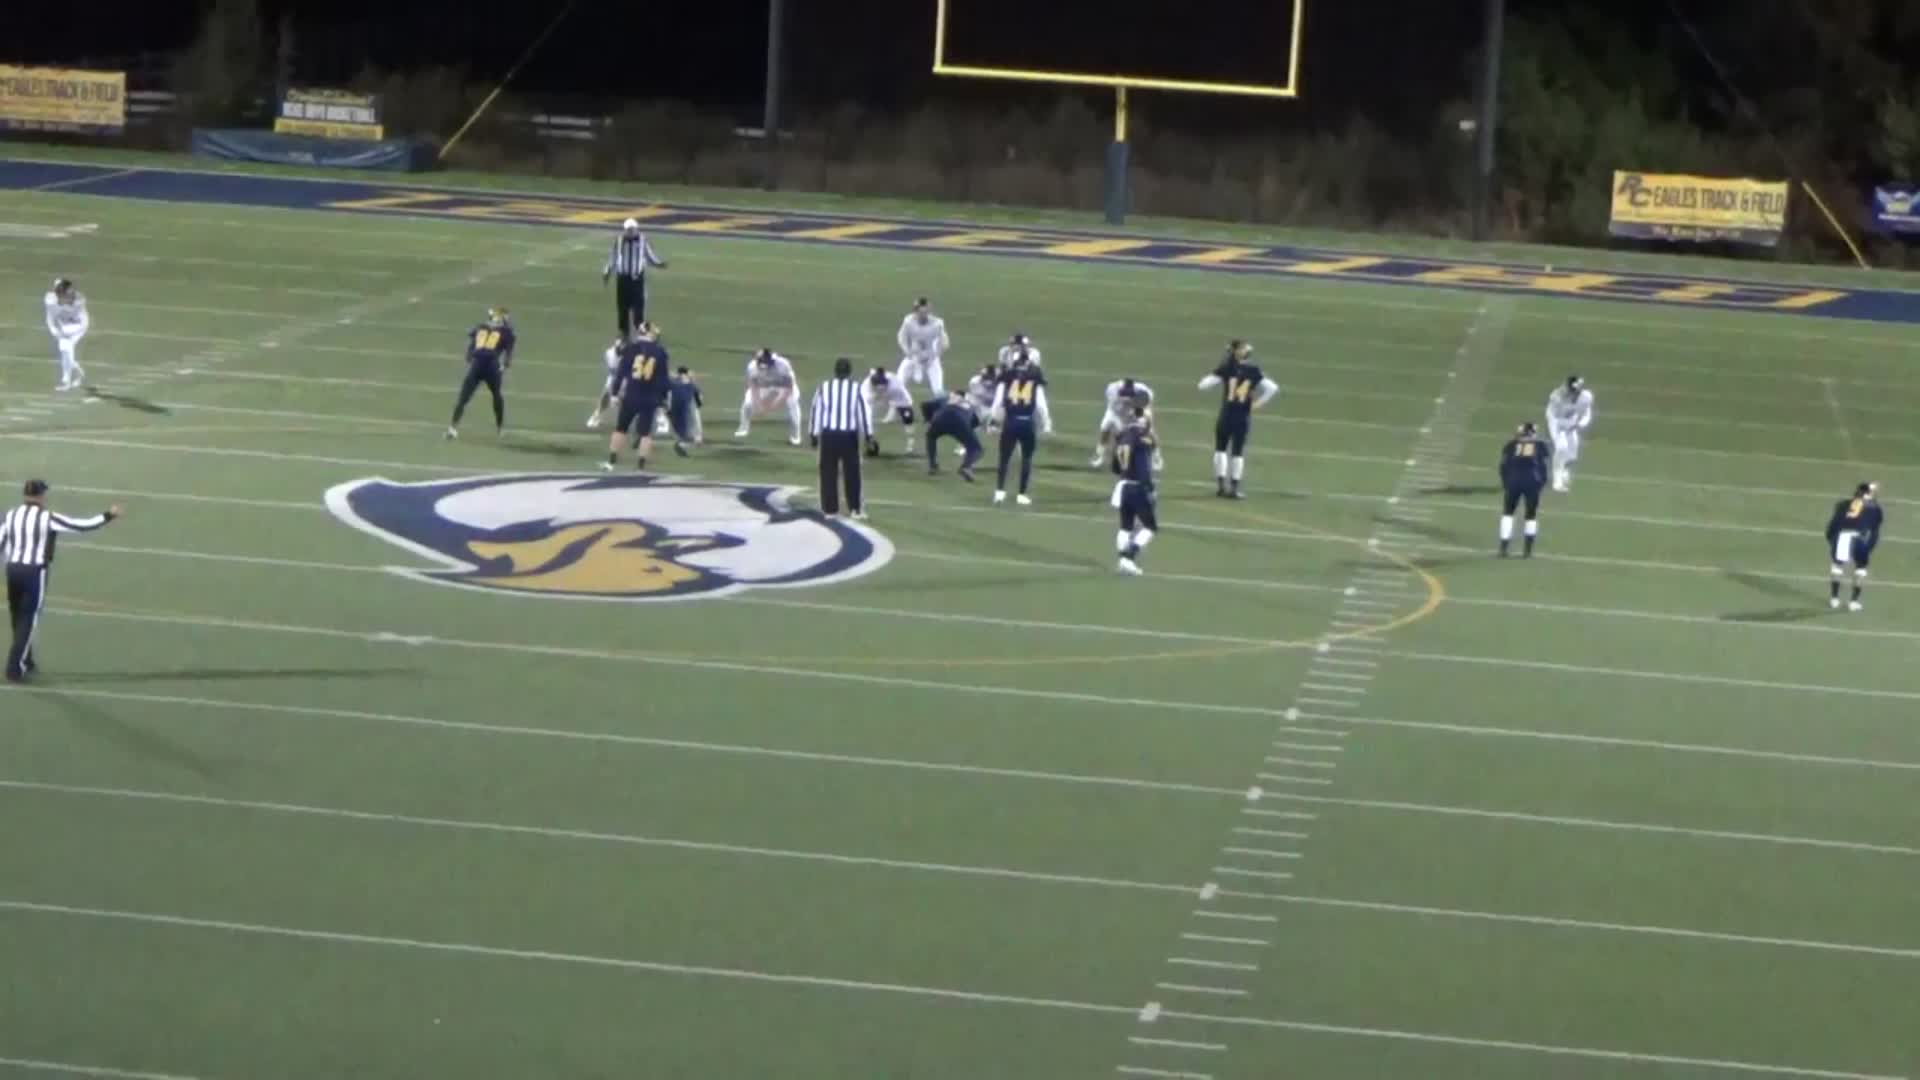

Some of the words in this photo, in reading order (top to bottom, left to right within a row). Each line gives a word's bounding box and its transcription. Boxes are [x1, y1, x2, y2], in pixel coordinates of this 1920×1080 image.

[1654, 186, 1697, 209] EAGLES
[1700, 188, 1738, 211] TRACK
[1750, 192, 1784, 215] FIELD
[1008, 379, 1033, 404] 44
[1227, 378, 1249, 402] 14
[1845, 498, 1863, 518] 9
